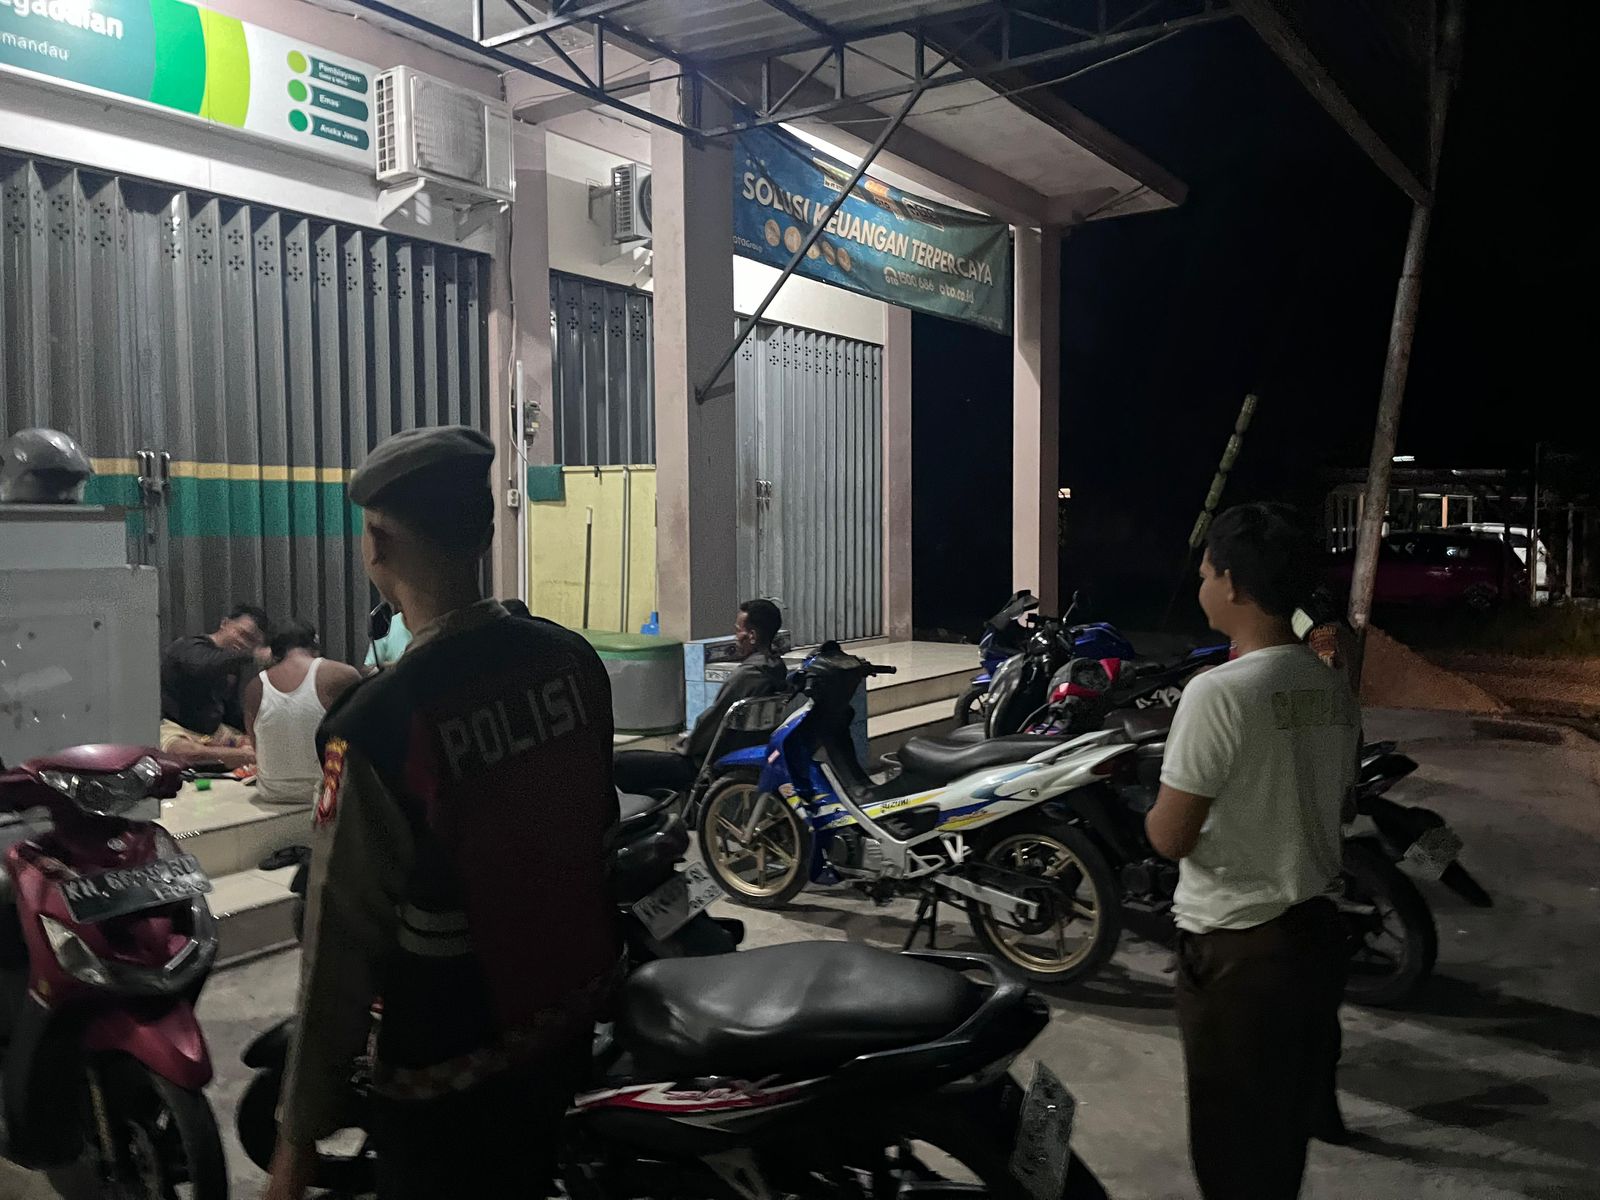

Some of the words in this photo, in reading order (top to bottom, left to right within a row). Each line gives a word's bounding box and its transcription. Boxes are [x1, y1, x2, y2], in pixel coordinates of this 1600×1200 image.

[0, 0, 124, 40] gadaian
[742, 171, 809, 224] SOLUSI
[812, 202, 909, 259] KEUANGAN
[910, 238, 994, 287] TERPERCAYA
[437, 672, 588, 780] POLISI
